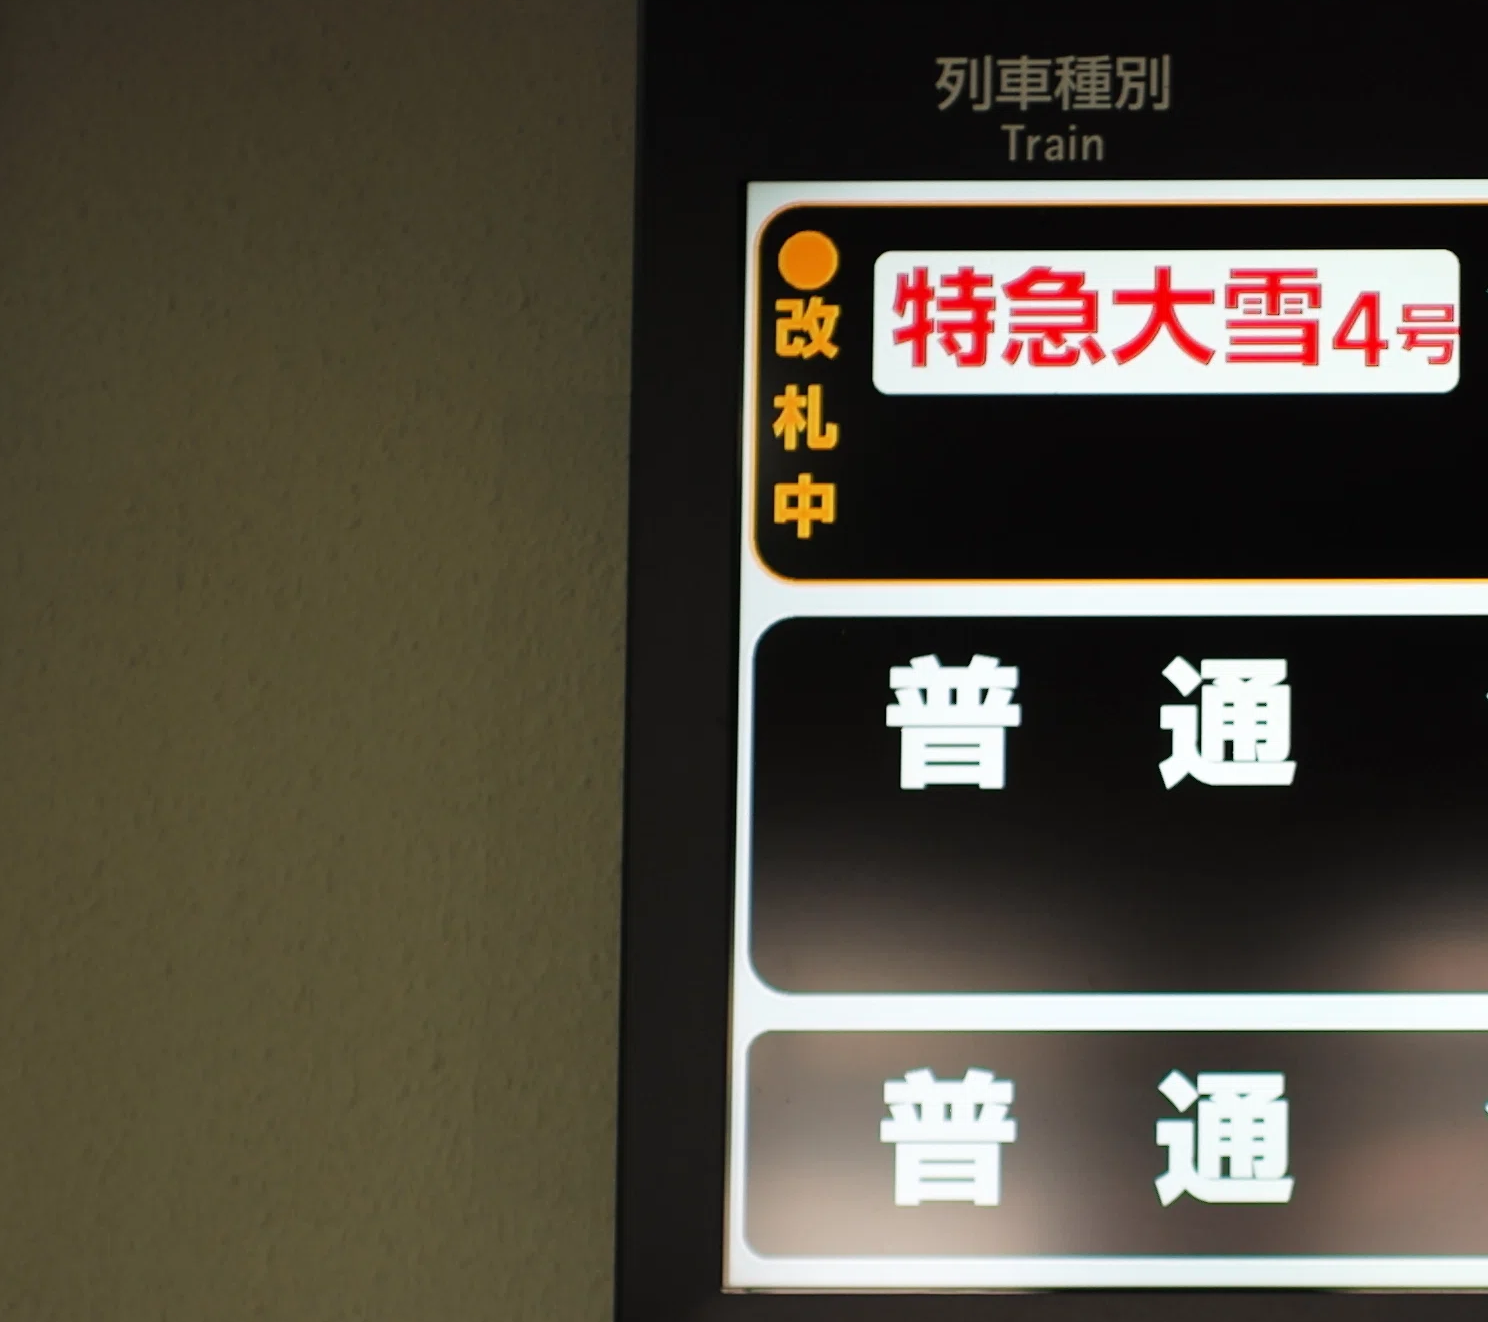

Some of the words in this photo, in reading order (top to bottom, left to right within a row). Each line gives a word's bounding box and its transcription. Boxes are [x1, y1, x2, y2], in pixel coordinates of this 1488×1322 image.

[934, 53, 1171, 113] 列車種別
[1000, 124, 1105, 163] Train
[891, 265, 1460, 369] 特急大雪4号
[772, 296, 841, 539] 改札中
